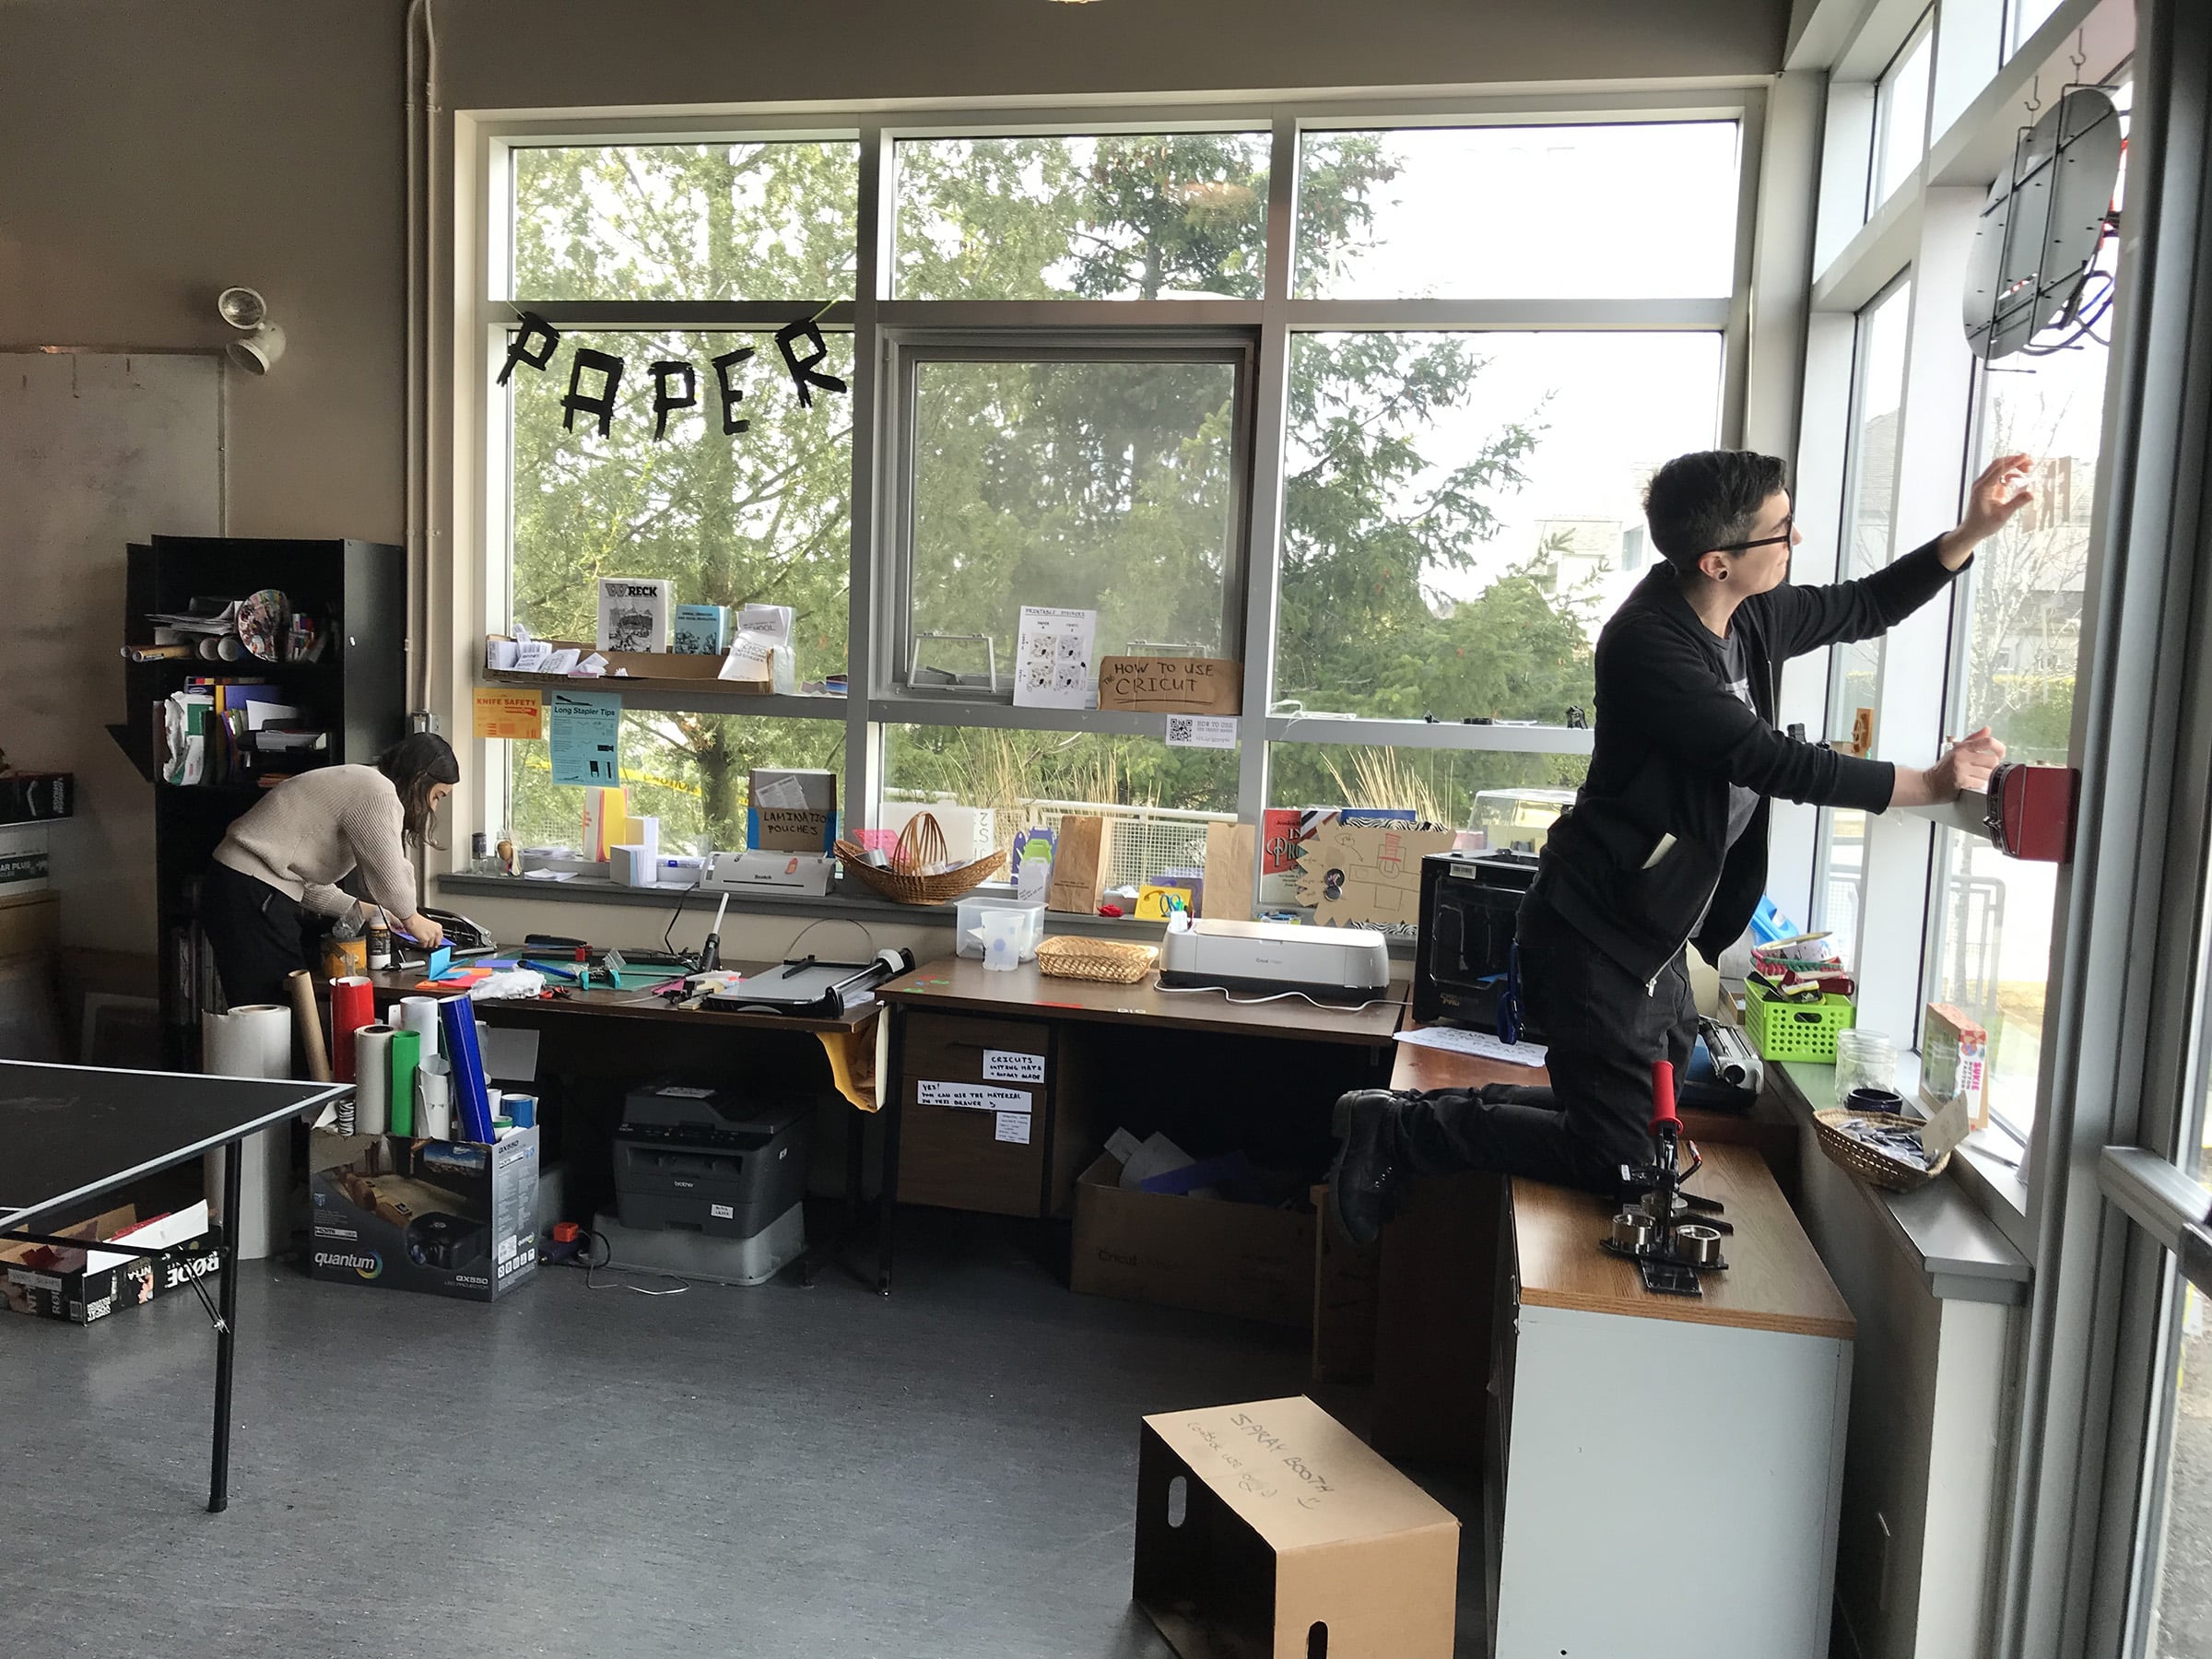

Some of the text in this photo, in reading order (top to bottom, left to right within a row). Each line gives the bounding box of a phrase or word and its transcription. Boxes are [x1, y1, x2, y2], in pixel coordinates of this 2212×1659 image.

[497, 312, 847, 442] PAPER
[605, 582, 657, 597] WRECK
[1115, 662, 1215, 677] HOW TO USE
[1115, 677, 1197, 695] CRICUT
[554, 706, 572, 715] Long
[573, 707, 599, 715] Stapler
[767, 825, 818, 835] POUCHES
[1971, 1062, 1982, 1091] SUKIE
[923, 1083, 940, 1091] YES!
[314, 1252, 376, 1270] quantum
[455, 1275, 488, 1285] QX550
[1230, 1413, 1288, 1453] SPRAY
[1283, 1456, 1335, 1493] BOOTH
